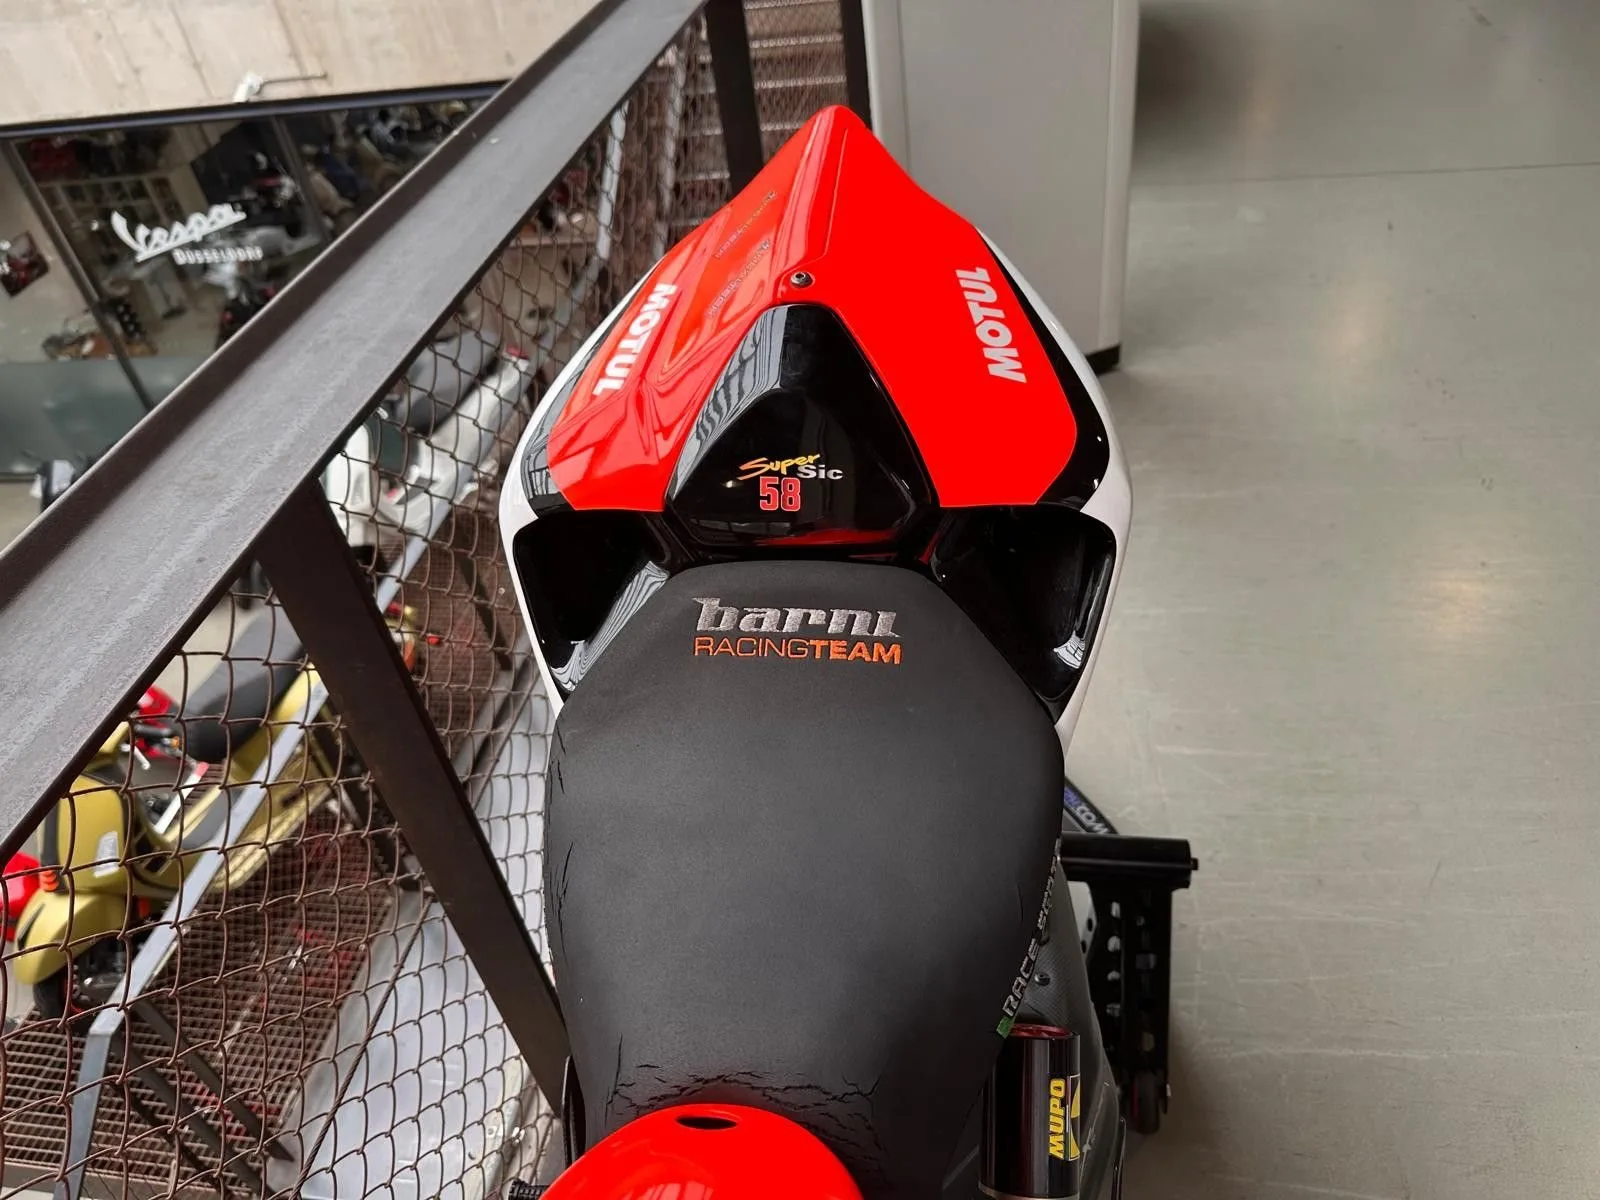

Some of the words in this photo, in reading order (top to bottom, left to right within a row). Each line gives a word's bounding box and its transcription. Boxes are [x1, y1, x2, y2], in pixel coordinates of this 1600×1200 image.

[111, 203, 247, 262] Vespa
[592, 282, 678, 396] MOTUL
[955, 266, 1028, 384] MOTUL
[736, 453, 821, 481] Super
[797, 464, 844, 480] Sic
[759, 476, 801, 512] 58
[691, 597, 903, 638] barni
[1002, 938, 1040, 1017] RACE
[1048, 1078, 1066, 1160] MUPO
